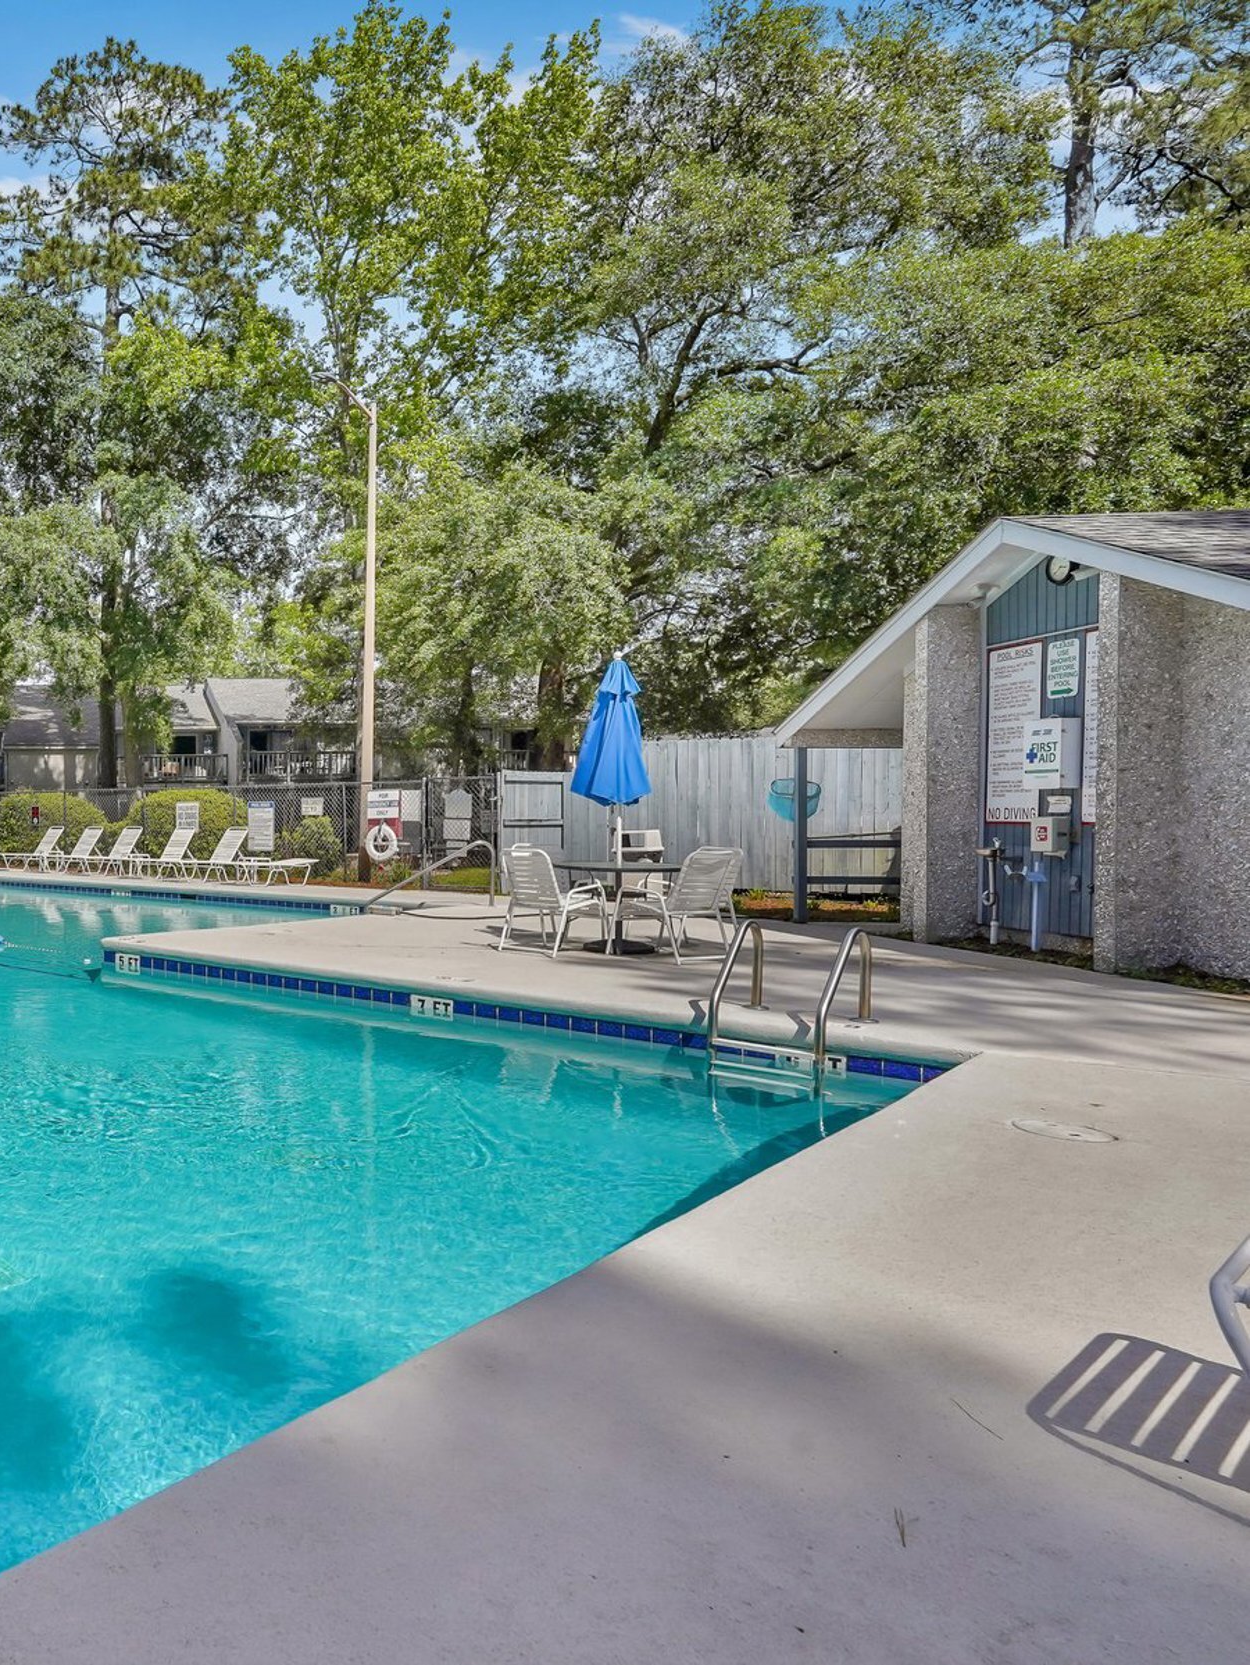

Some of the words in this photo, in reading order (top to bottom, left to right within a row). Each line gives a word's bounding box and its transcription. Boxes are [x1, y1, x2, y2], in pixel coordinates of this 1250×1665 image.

[1052, 640, 1075, 650] PLEASE
[997, 652, 1014, 662] POOL
[1057, 649, 1069, 657] USE
[1050, 656, 1077, 666] SHOWER
[1051, 664, 1075, 672] BEFORE
[1049, 671, 1078, 680] ENTERING
[1053, 680, 1071, 688] POOL
[1031, 741, 1058, 752] FIRST
[1038, 752, 1056, 763] AID
[988, 807, 1001, 819] NO
[1003, 807, 1036, 819] DIVING
